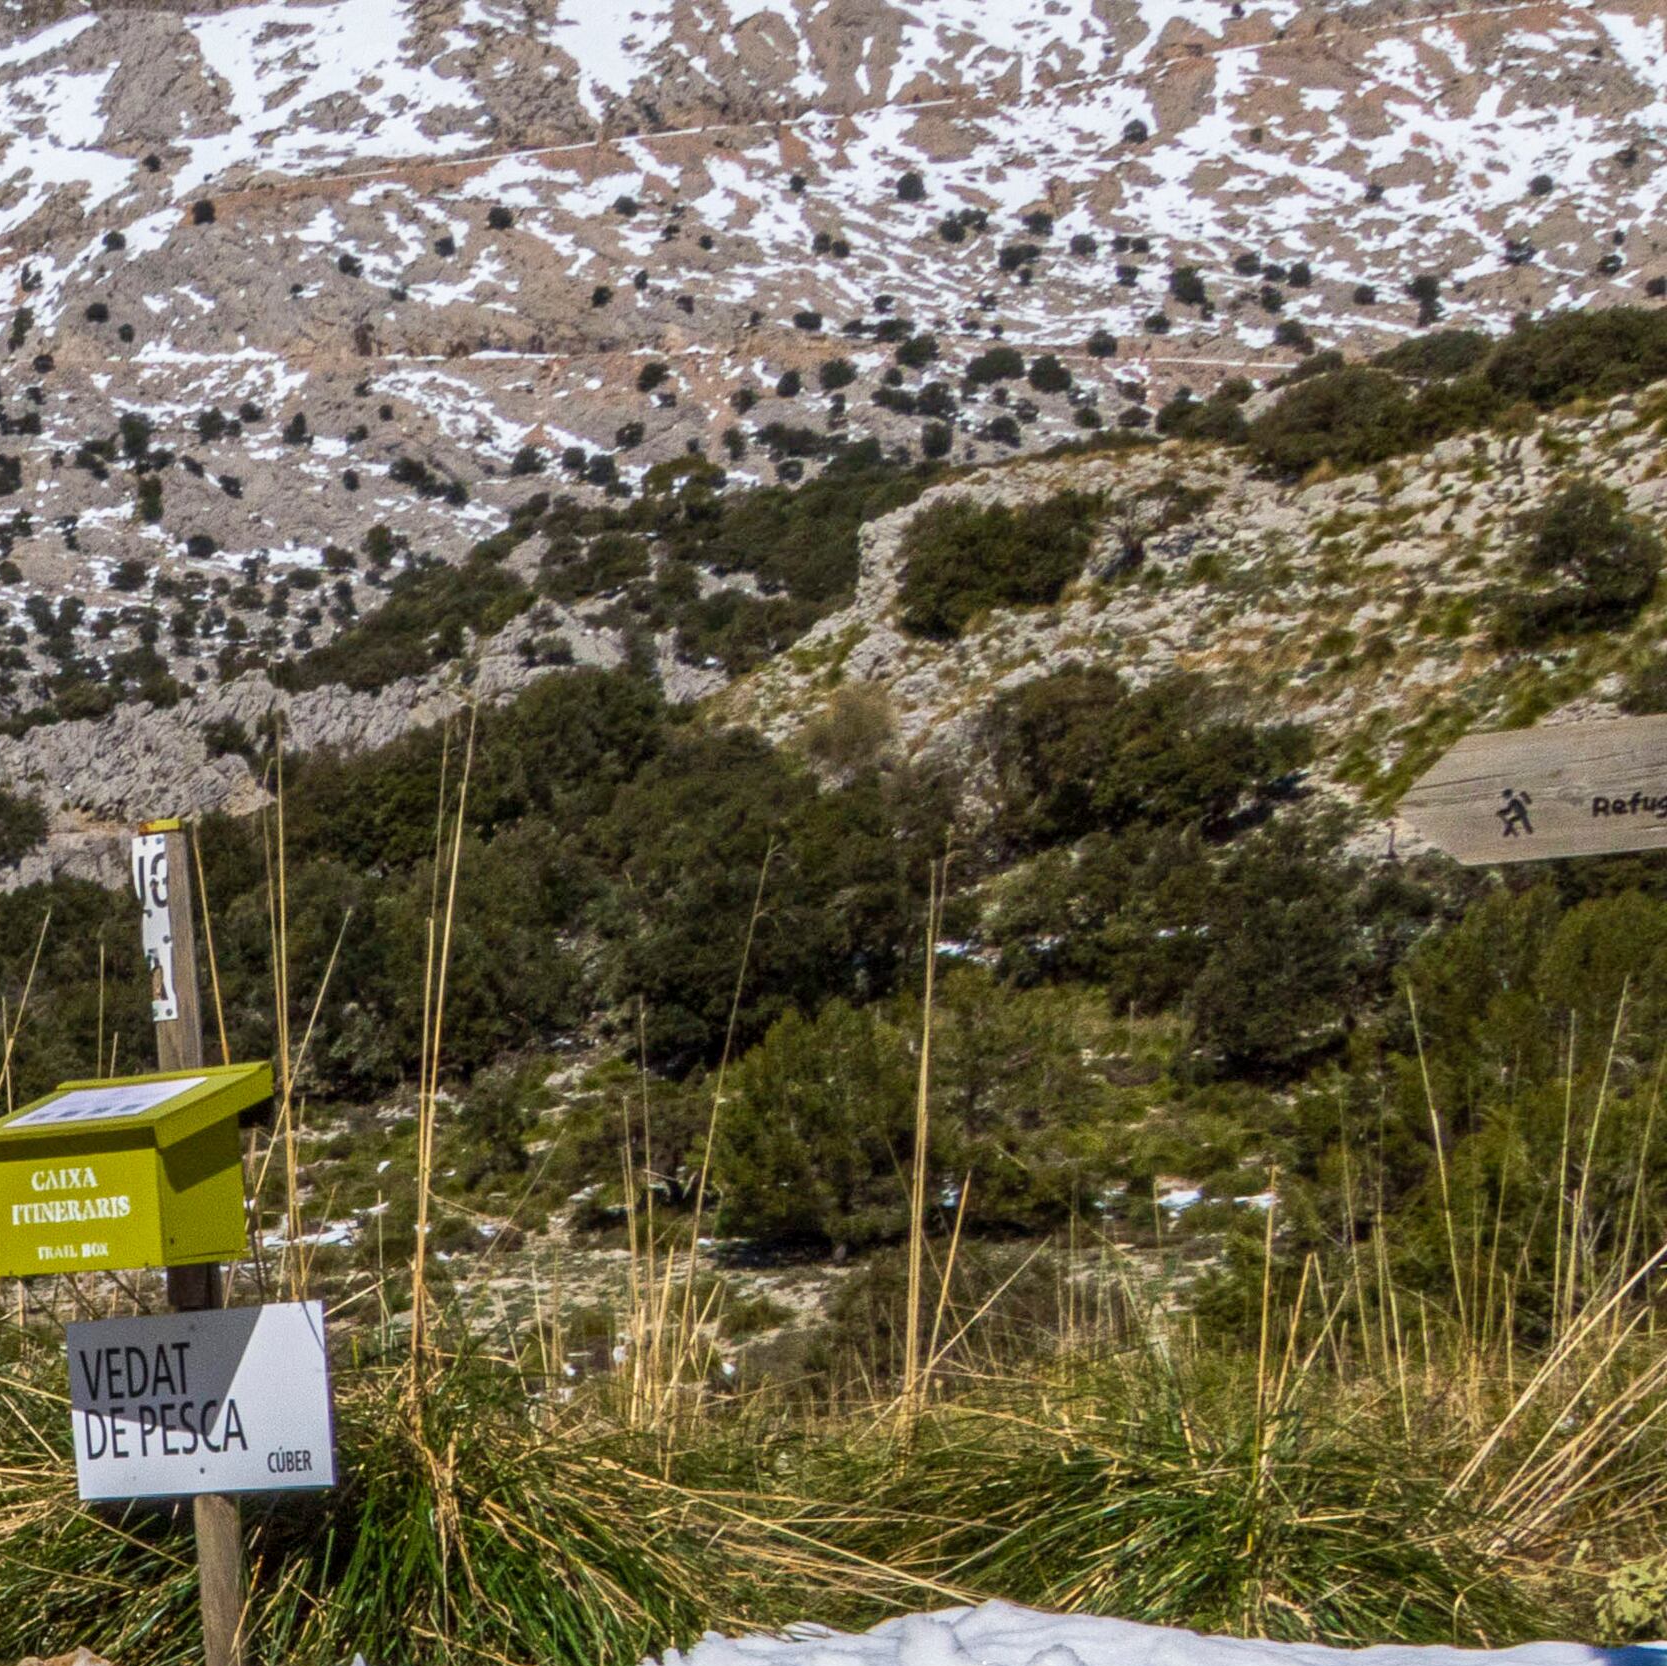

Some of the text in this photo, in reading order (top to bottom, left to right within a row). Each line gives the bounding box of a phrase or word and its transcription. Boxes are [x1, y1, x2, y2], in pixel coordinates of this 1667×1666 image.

[31, 1167, 98, 1191] CAIXA
[12, 1195, 130, 1226] ITINERARIS
[38, 1242, 108, 1260] TRAIL BOX
[80, 1342, 191, 1400] VEDAT
[84, 1399, 249, 1460] DE PESCA
[267, 1446, 313, 1473] CÚBER
